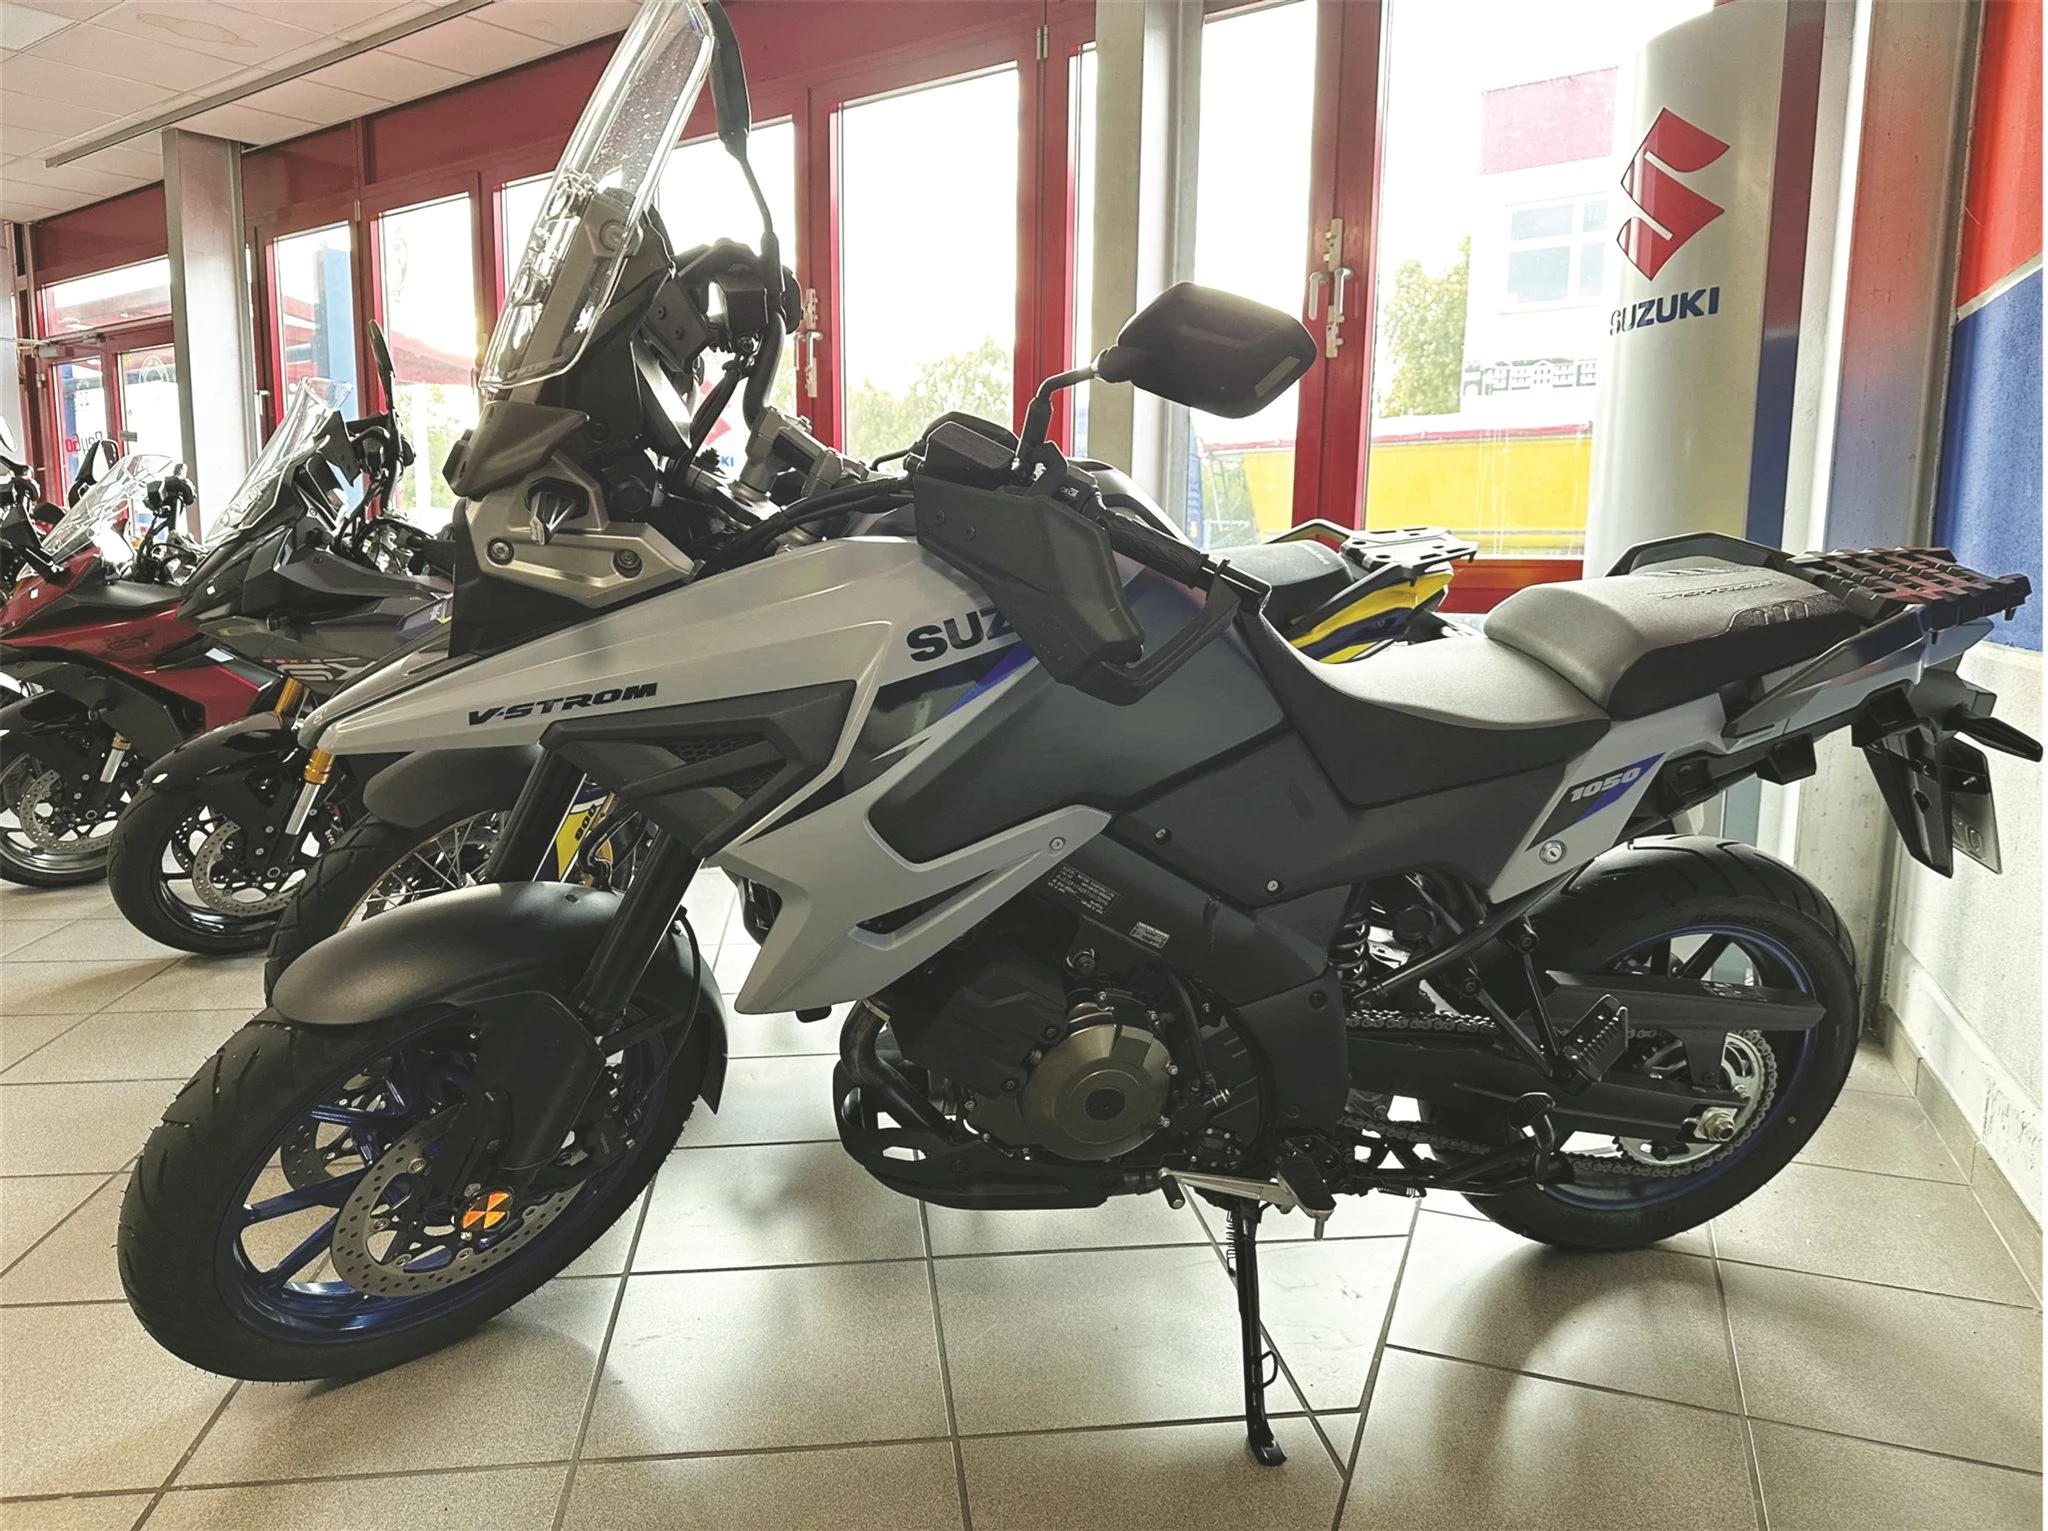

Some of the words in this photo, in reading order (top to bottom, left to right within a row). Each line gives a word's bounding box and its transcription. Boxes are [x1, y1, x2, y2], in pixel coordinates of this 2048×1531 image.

[1609, 286, 1720, 336] SUZUKI
[468, 682, 659, 726] V-STROM
[1570, 767, 1642, 803] 1050
